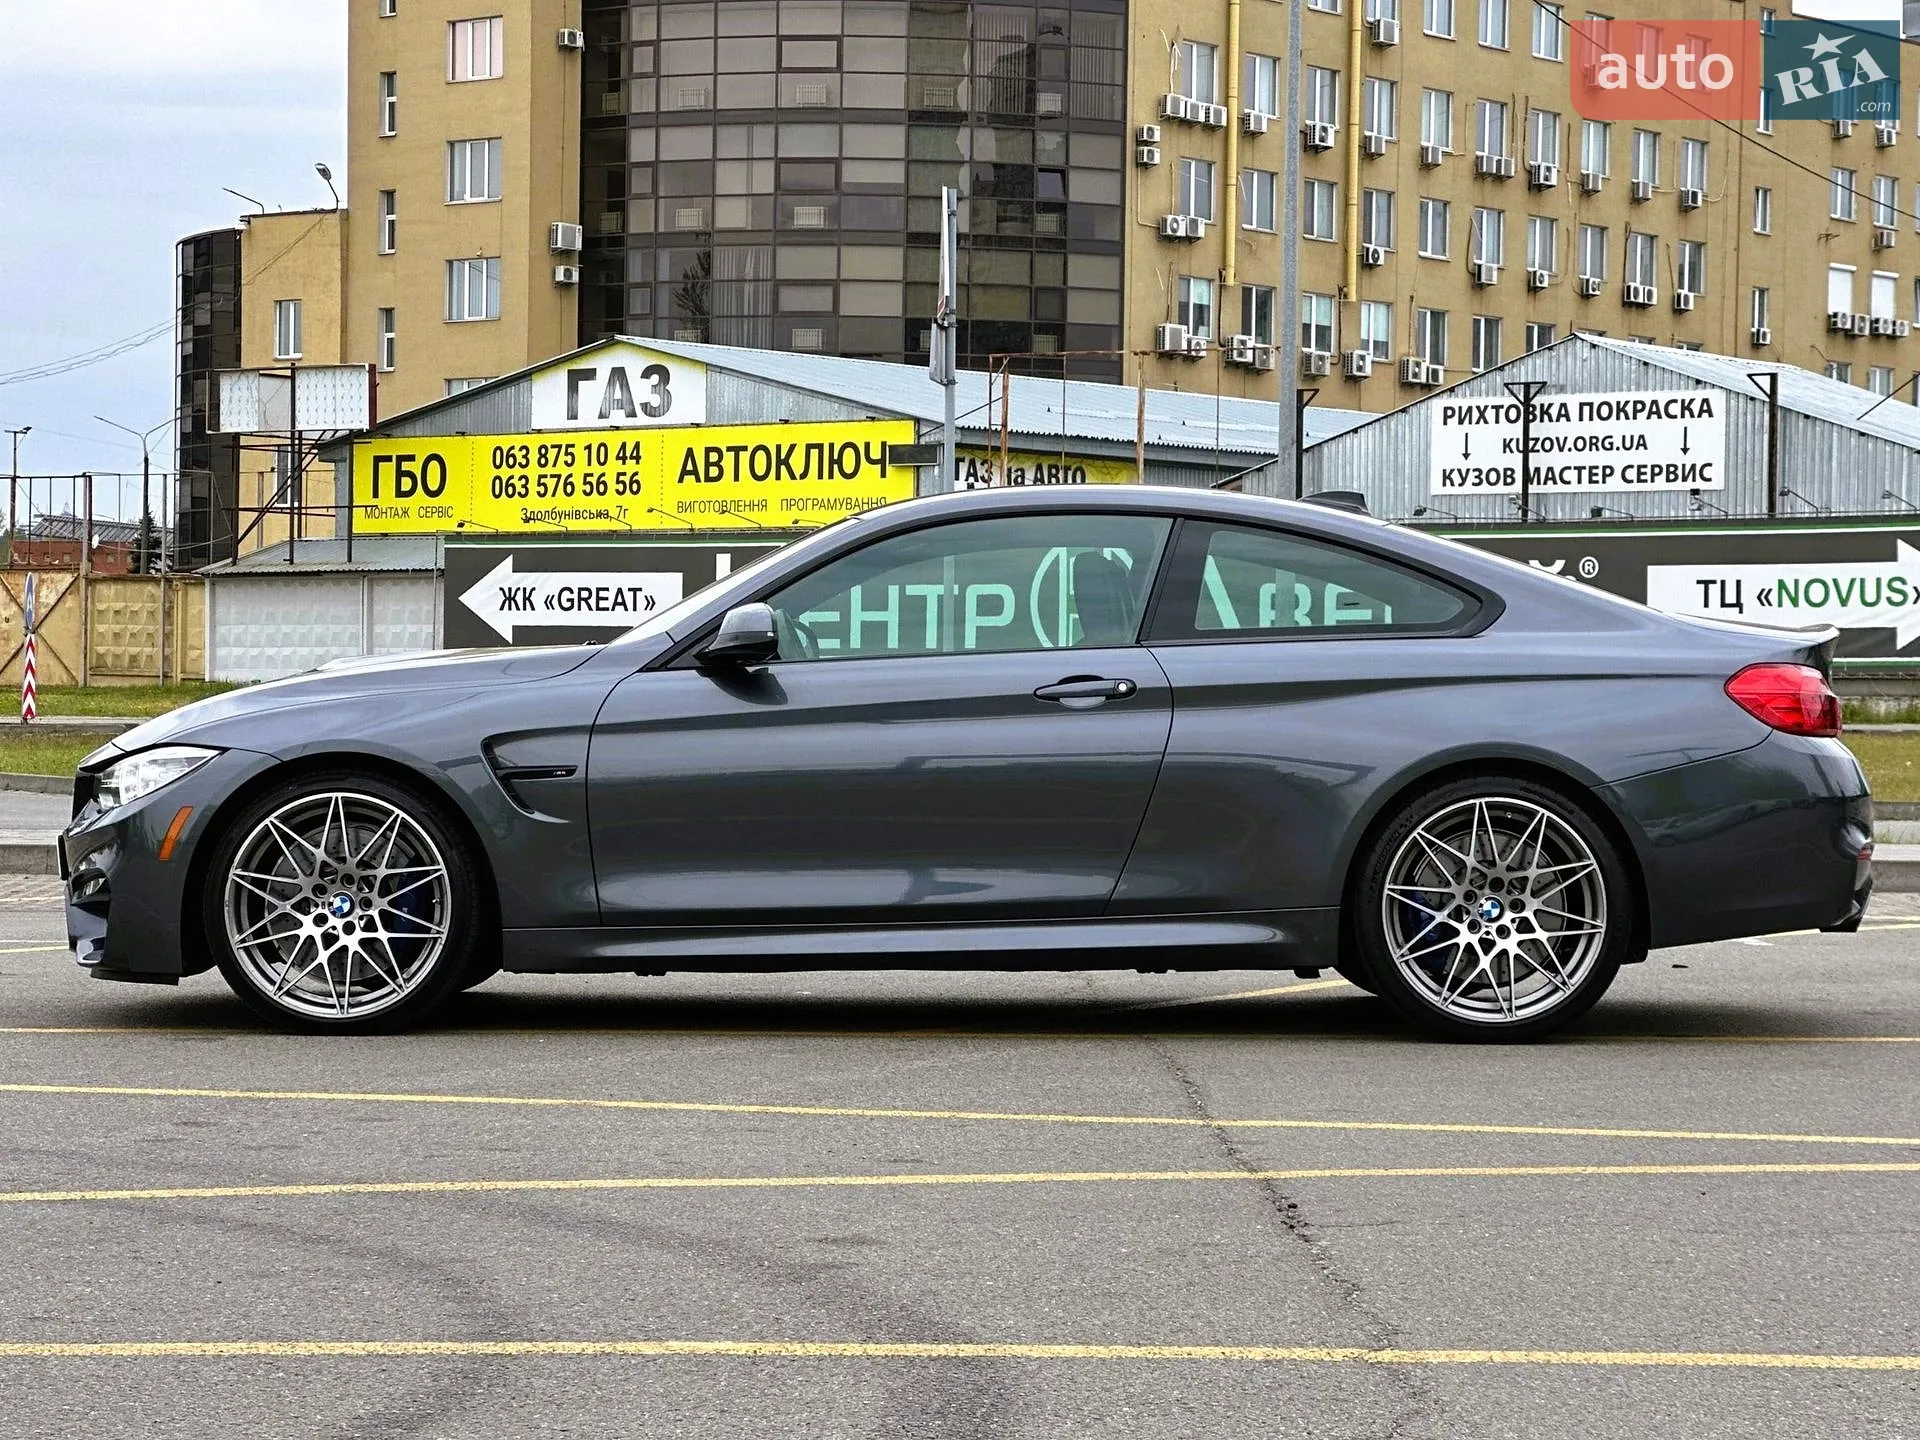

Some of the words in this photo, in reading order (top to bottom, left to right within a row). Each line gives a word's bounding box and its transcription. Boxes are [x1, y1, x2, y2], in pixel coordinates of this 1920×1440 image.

[566, 363, 673, 421] ГАЗ
[1442, 402, 1571, 426] РИХТОВКА
[1578, 397, 1714, 423] ПОКРАСКА
[492, 445, 530, 470] 063
[536, 443, 576, 469] 875
[583, 441, 609, 467] 10
[615, 440, 642, 466] 44
[1502, 434, 1648, 454] KUZOV.ORG.UA
[371, 452, 447, 500] ГБО
[677, 440, 888, 484] АВТОКЛЮЧ
[1442, 467, 1516, 487] КУЗОВ
[1527, 464, 1615, 486] МАСТЕР
[1621, 462, 1713, 484] СЕРВИС
[491, 474, 530, 500] 063
[536, 472, 576, 499] 576
[582, 472, 608, 497] 56
[614, 471, 641, 497] 56
[364, 505, 410, 519] МОНТАЖ
[417, 505, 454, 519] СЕРВІС
[616, 505, 629, 519] 7г
[677, 498, 768, 514] ВИГОТОВЛЕННЯ
[780, 496, 887, 513] ПРОГРАМУВАННЯ
[498, 587, 536, 612] ЖК
[543, 587, 656, 612] «GREAT»
[1696, 579, 1744, 614] ТЦ
